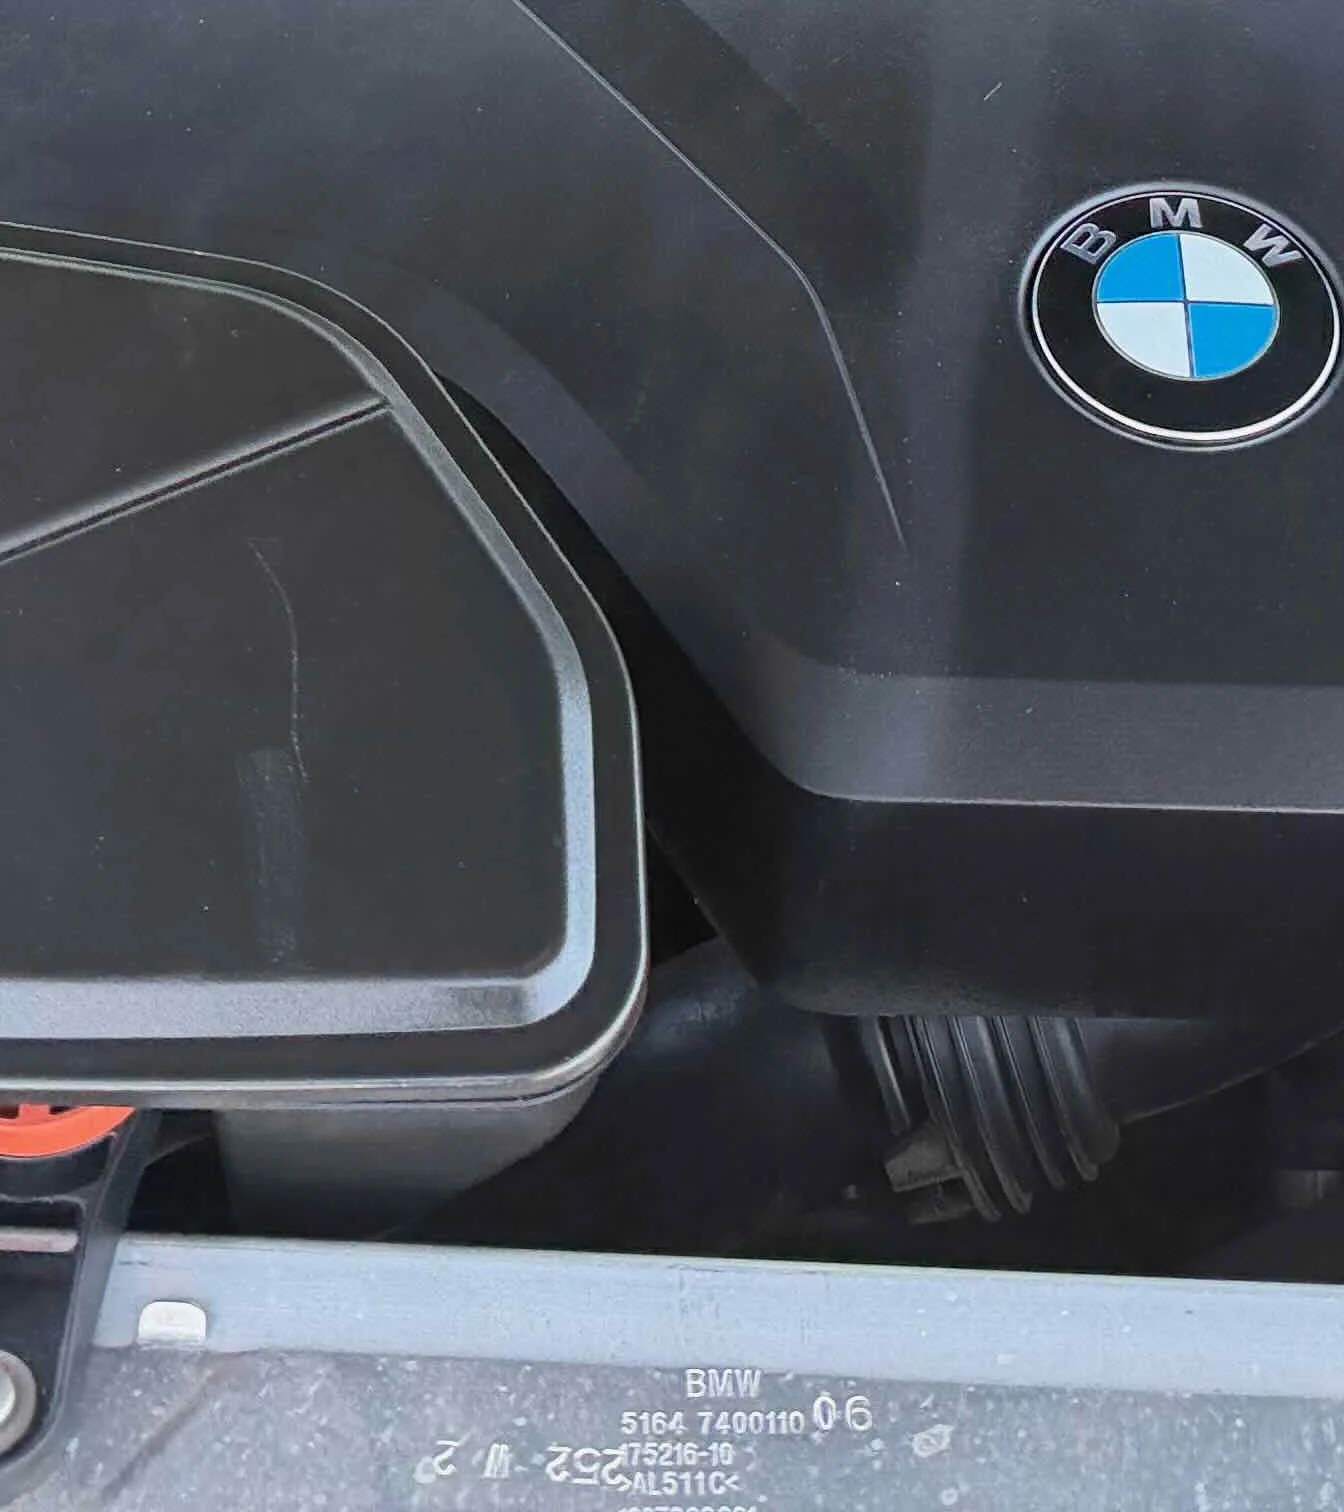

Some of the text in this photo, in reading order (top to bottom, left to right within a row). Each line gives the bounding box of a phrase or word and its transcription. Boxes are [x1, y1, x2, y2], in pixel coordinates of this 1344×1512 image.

[1060, 197, 1305, 268] BMW
[685, 1368, 762, 1399] BMW
[620, 1410, 805, 1436] 5164 7400110
